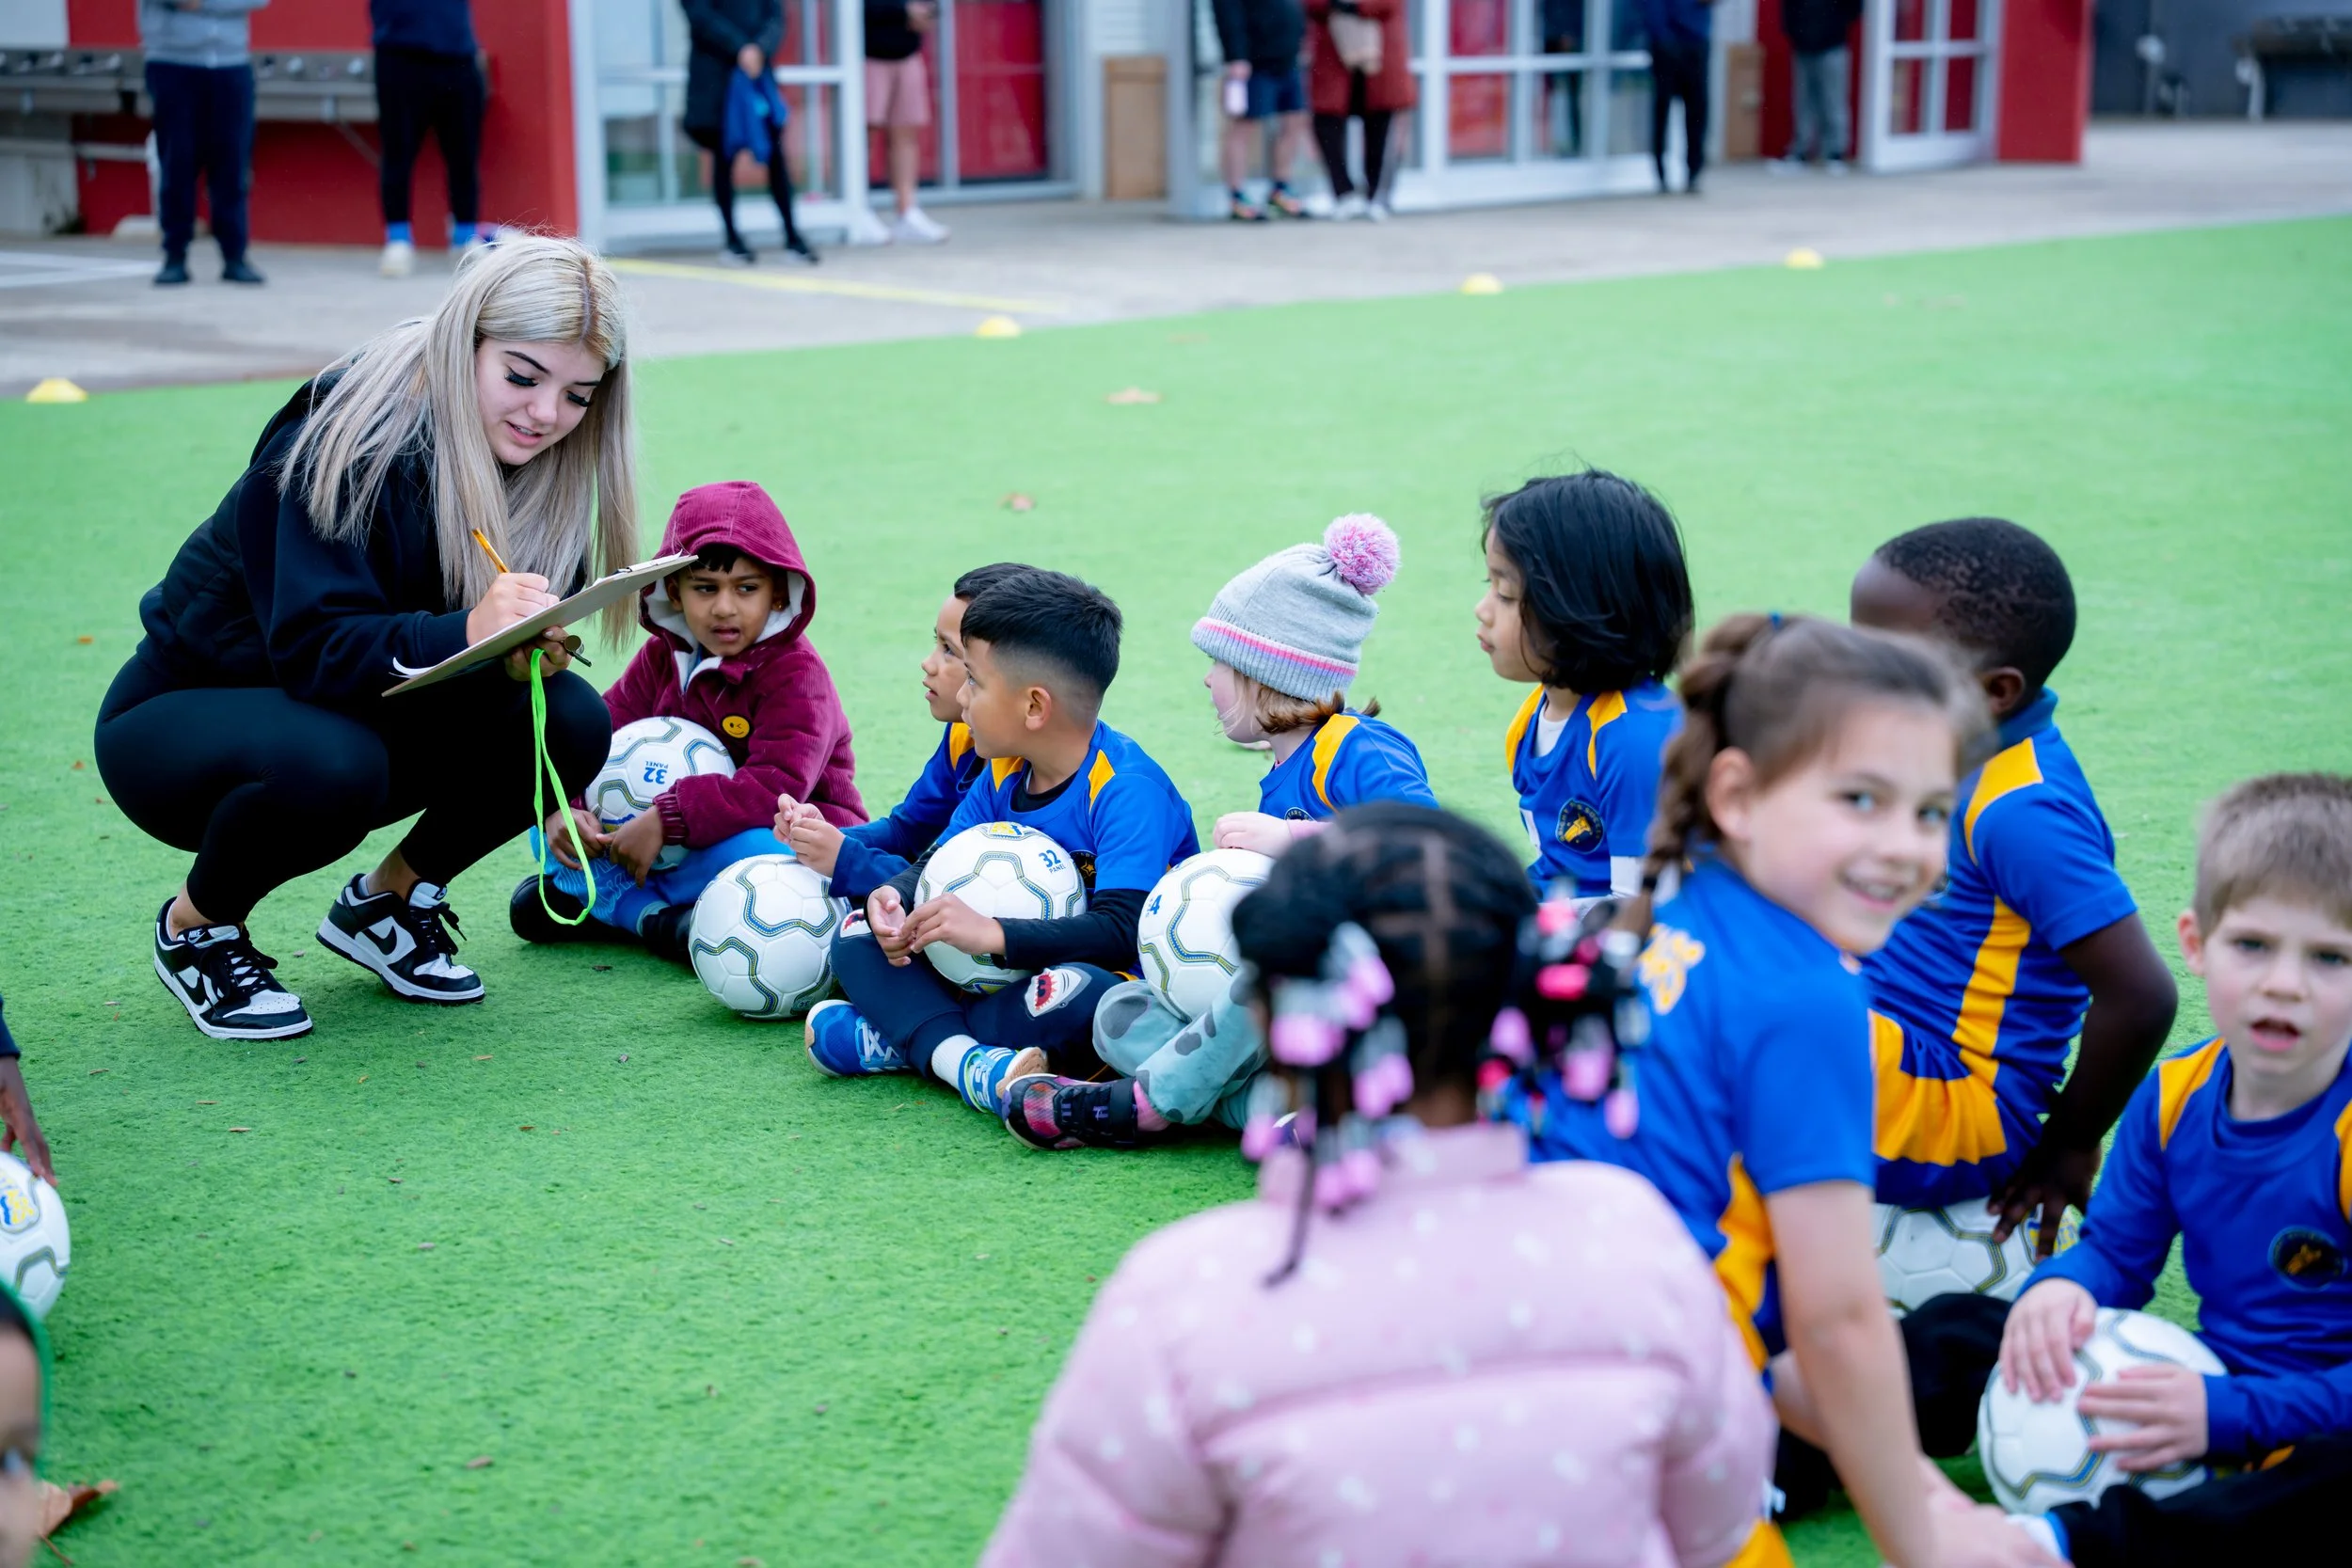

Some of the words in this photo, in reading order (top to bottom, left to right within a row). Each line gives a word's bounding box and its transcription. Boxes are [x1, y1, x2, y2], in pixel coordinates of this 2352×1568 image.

[644, 767, 667, 784] 32
[1039, 849, 1061, 867] 32
[1049, 864, 1067, 873] PANEL
[189, 928, 202, 938] NIKE
